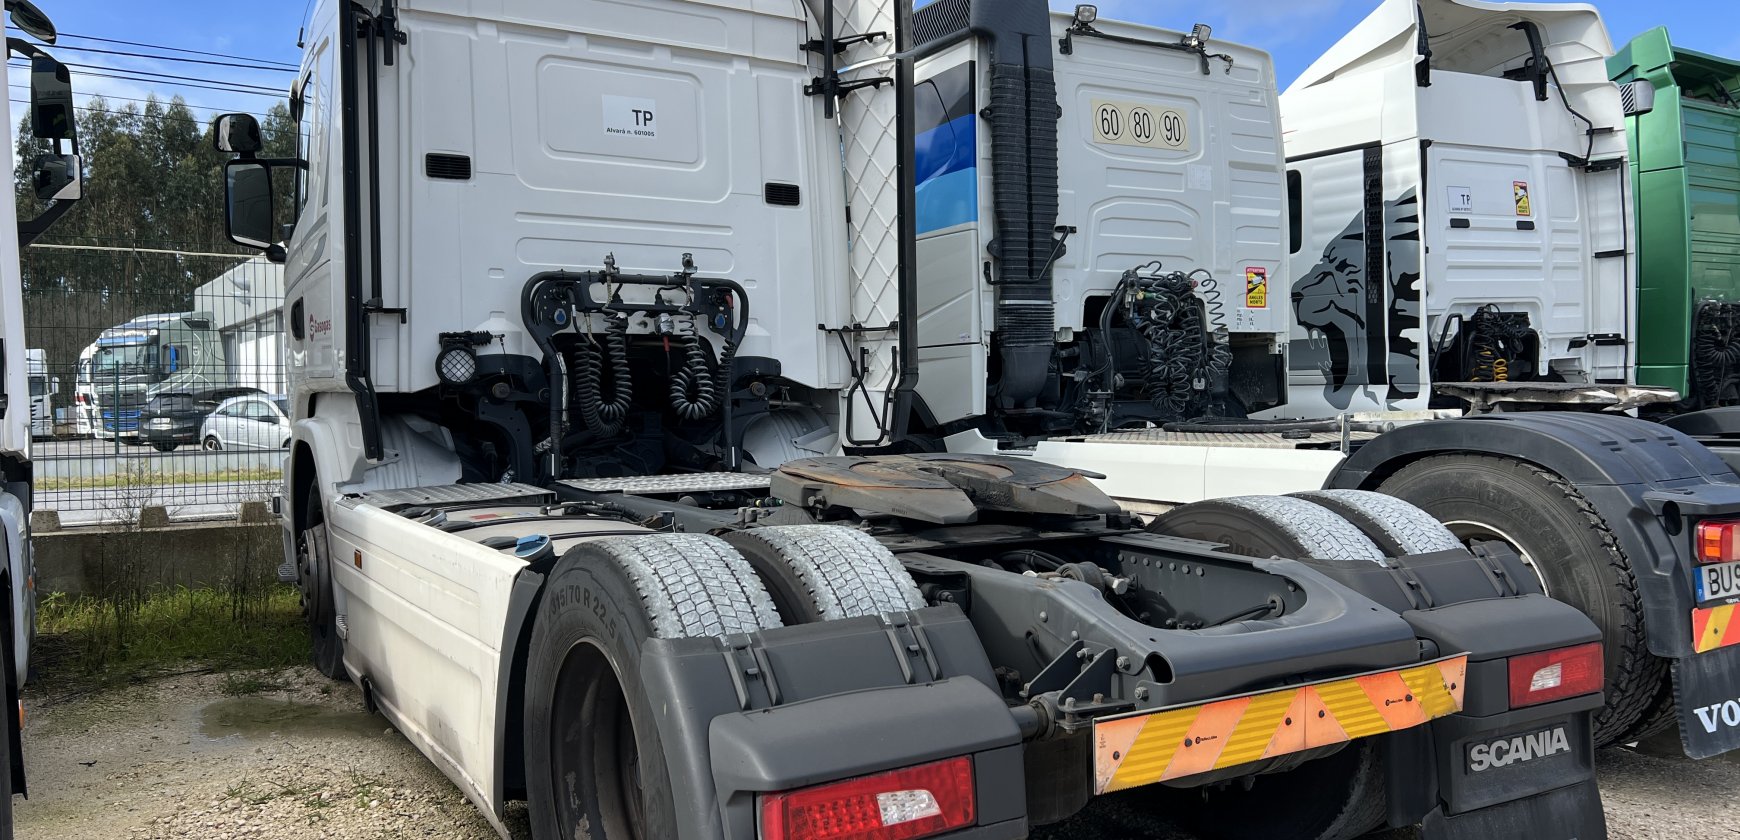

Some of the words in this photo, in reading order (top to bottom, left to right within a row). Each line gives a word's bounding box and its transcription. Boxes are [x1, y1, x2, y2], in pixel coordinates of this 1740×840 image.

[631, 109, 654, 127] TP
[1101, 108, 1119, 136] 60
[1133, 111, 1151, 139] 80
[1164, 114, 1181, 142] 90
[1460, 194, 1471, 205] TP
[550, 584, 581, 616] 315/70
[583, 586, 591, 609] R
[592, 595, 617, 640] 22.5
[1693, 697, 1740, 733] VO
[1470, 727, 1570, 772] SCANIA
